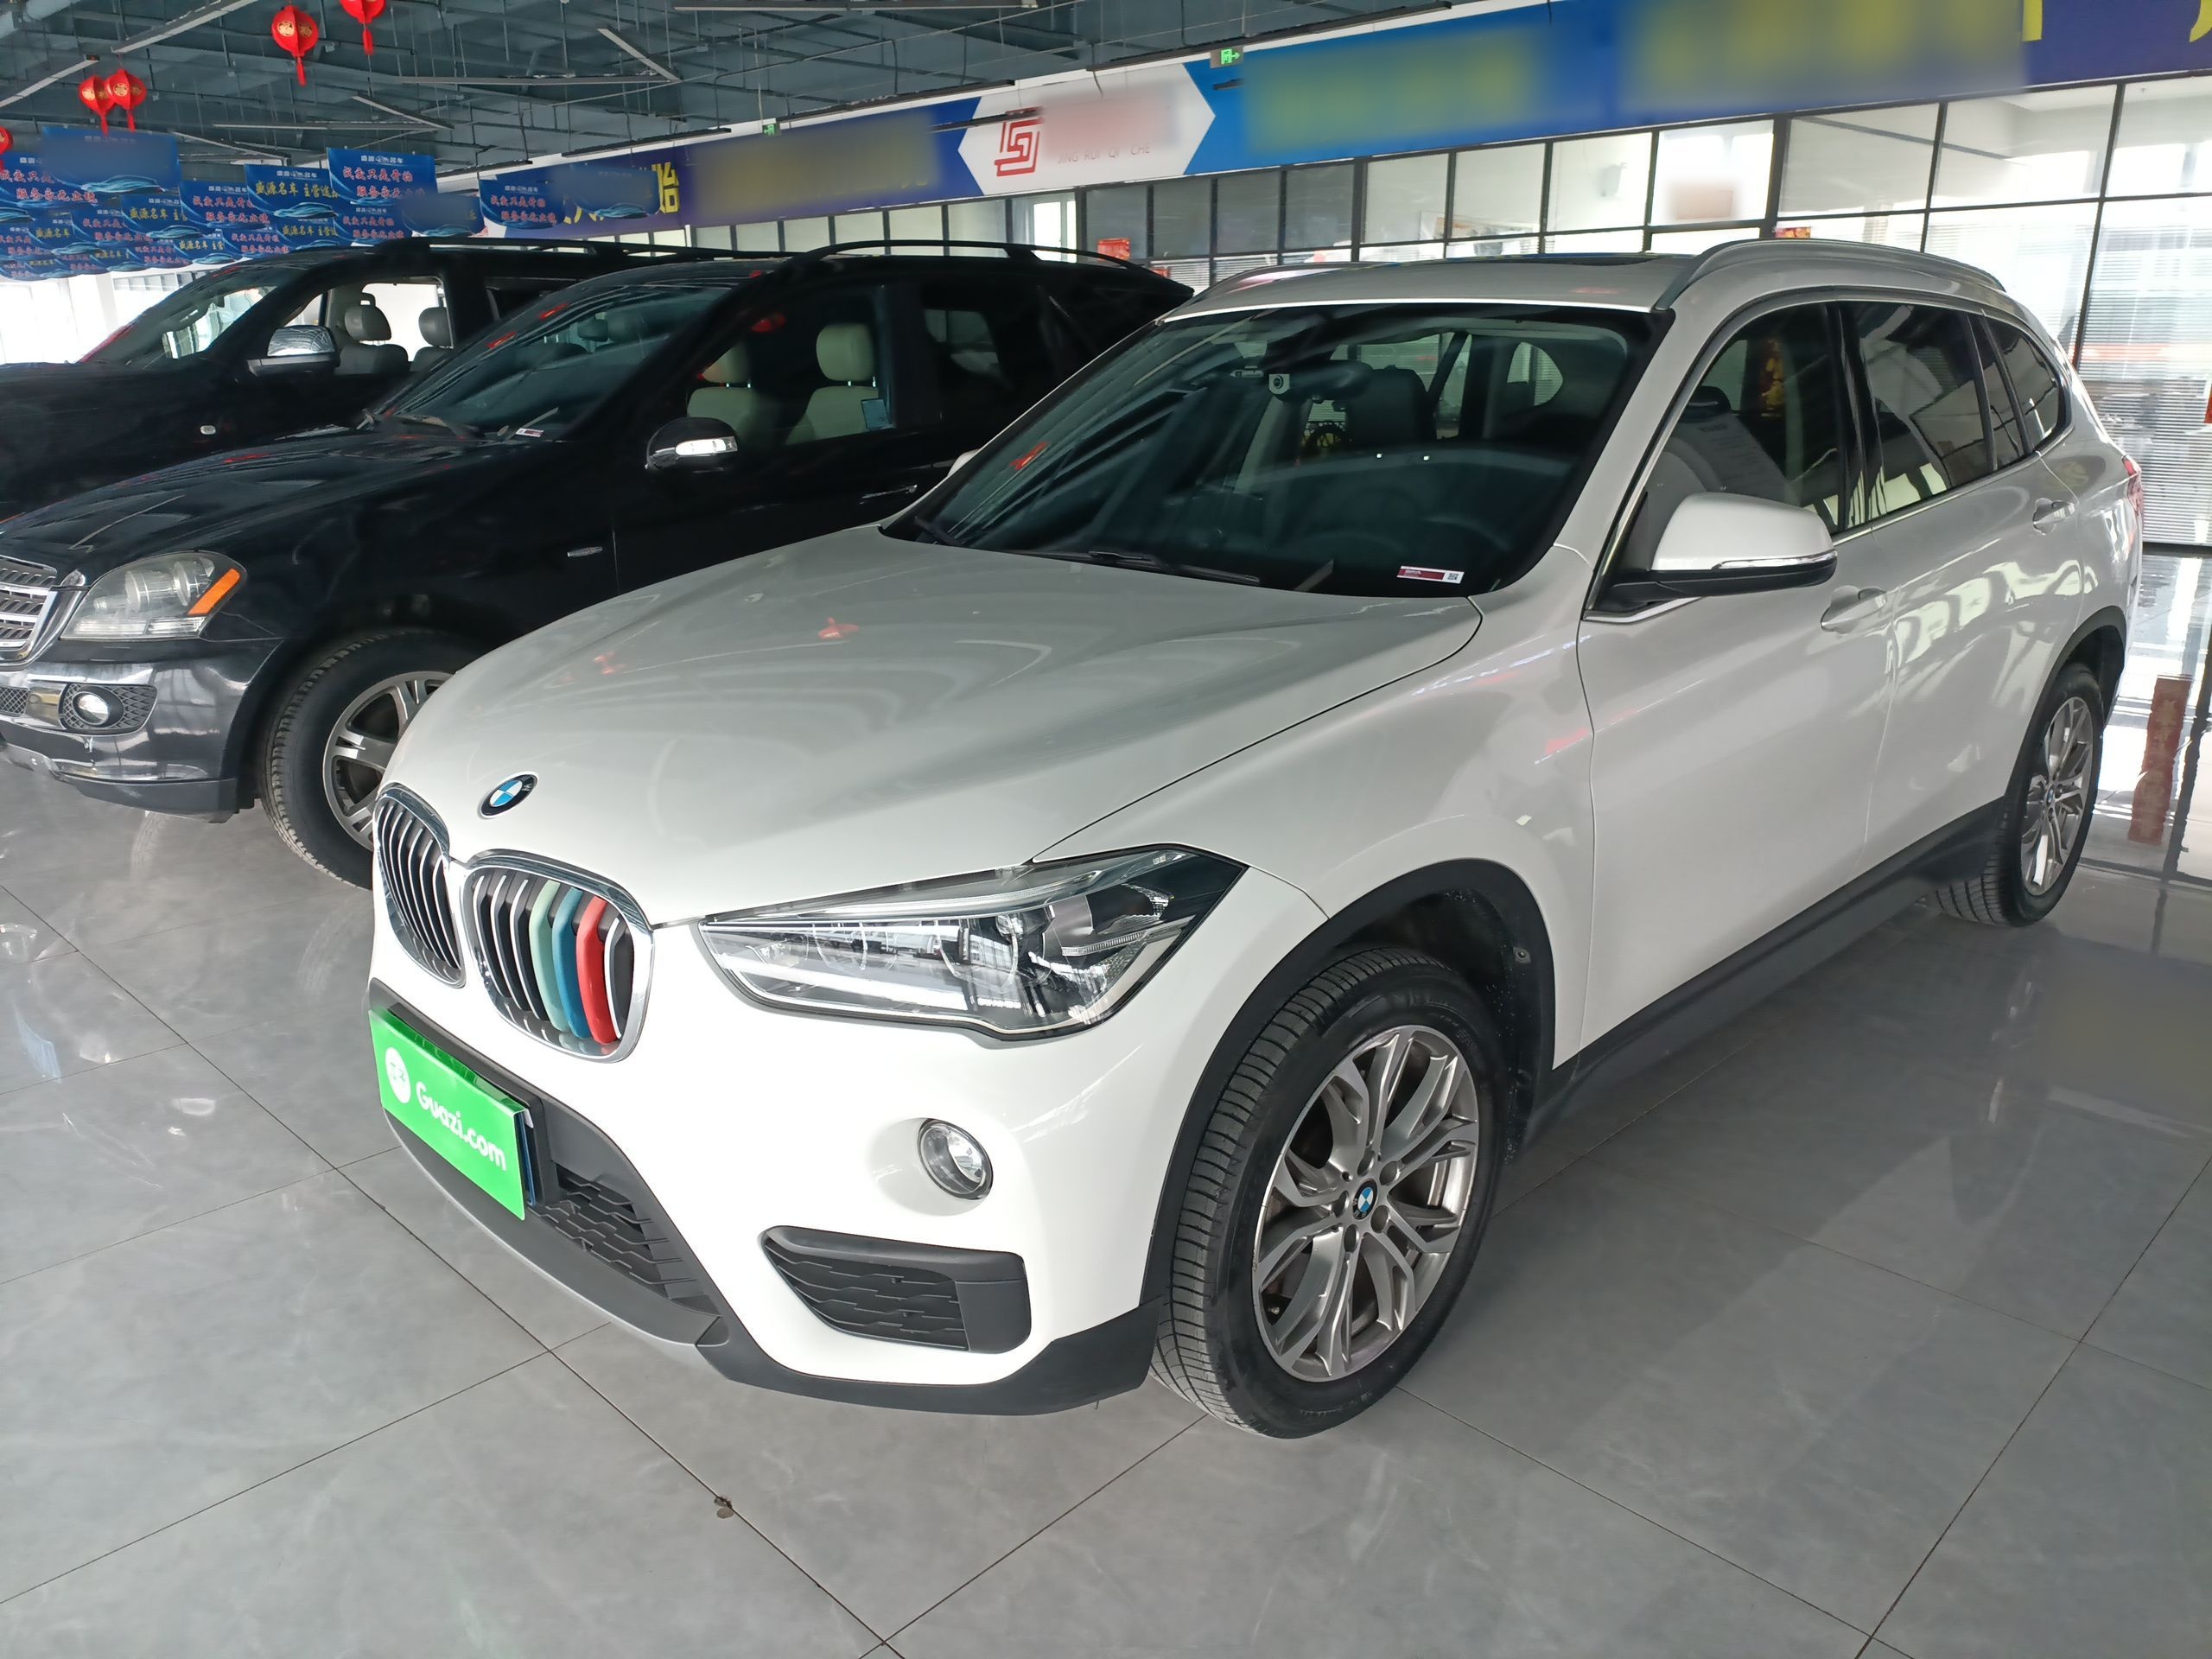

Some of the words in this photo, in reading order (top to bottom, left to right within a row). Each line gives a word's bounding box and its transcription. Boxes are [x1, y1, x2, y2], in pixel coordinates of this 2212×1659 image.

[1084, 149, 1101, 162] RUI
[1108, 146, 1120, 158] QI
[1129, 143, 1151, 156] CHE
[416, 1080, 508, 1173] Guazi.com
